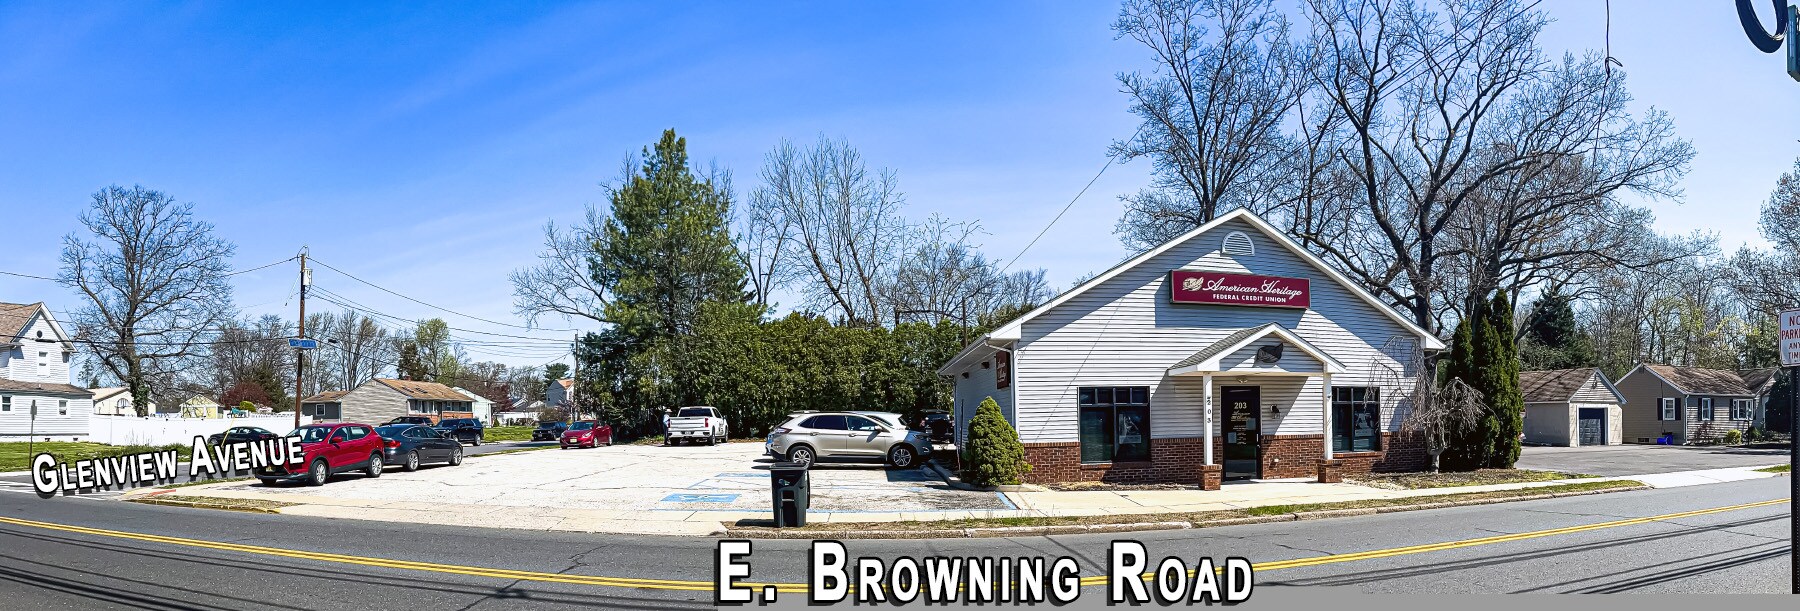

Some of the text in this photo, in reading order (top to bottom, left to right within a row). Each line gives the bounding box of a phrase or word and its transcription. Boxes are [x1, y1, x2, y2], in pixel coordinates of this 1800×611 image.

[1202, 277, 1303, 300] American Heritage
[1233, 401, 1248, 410] 203
